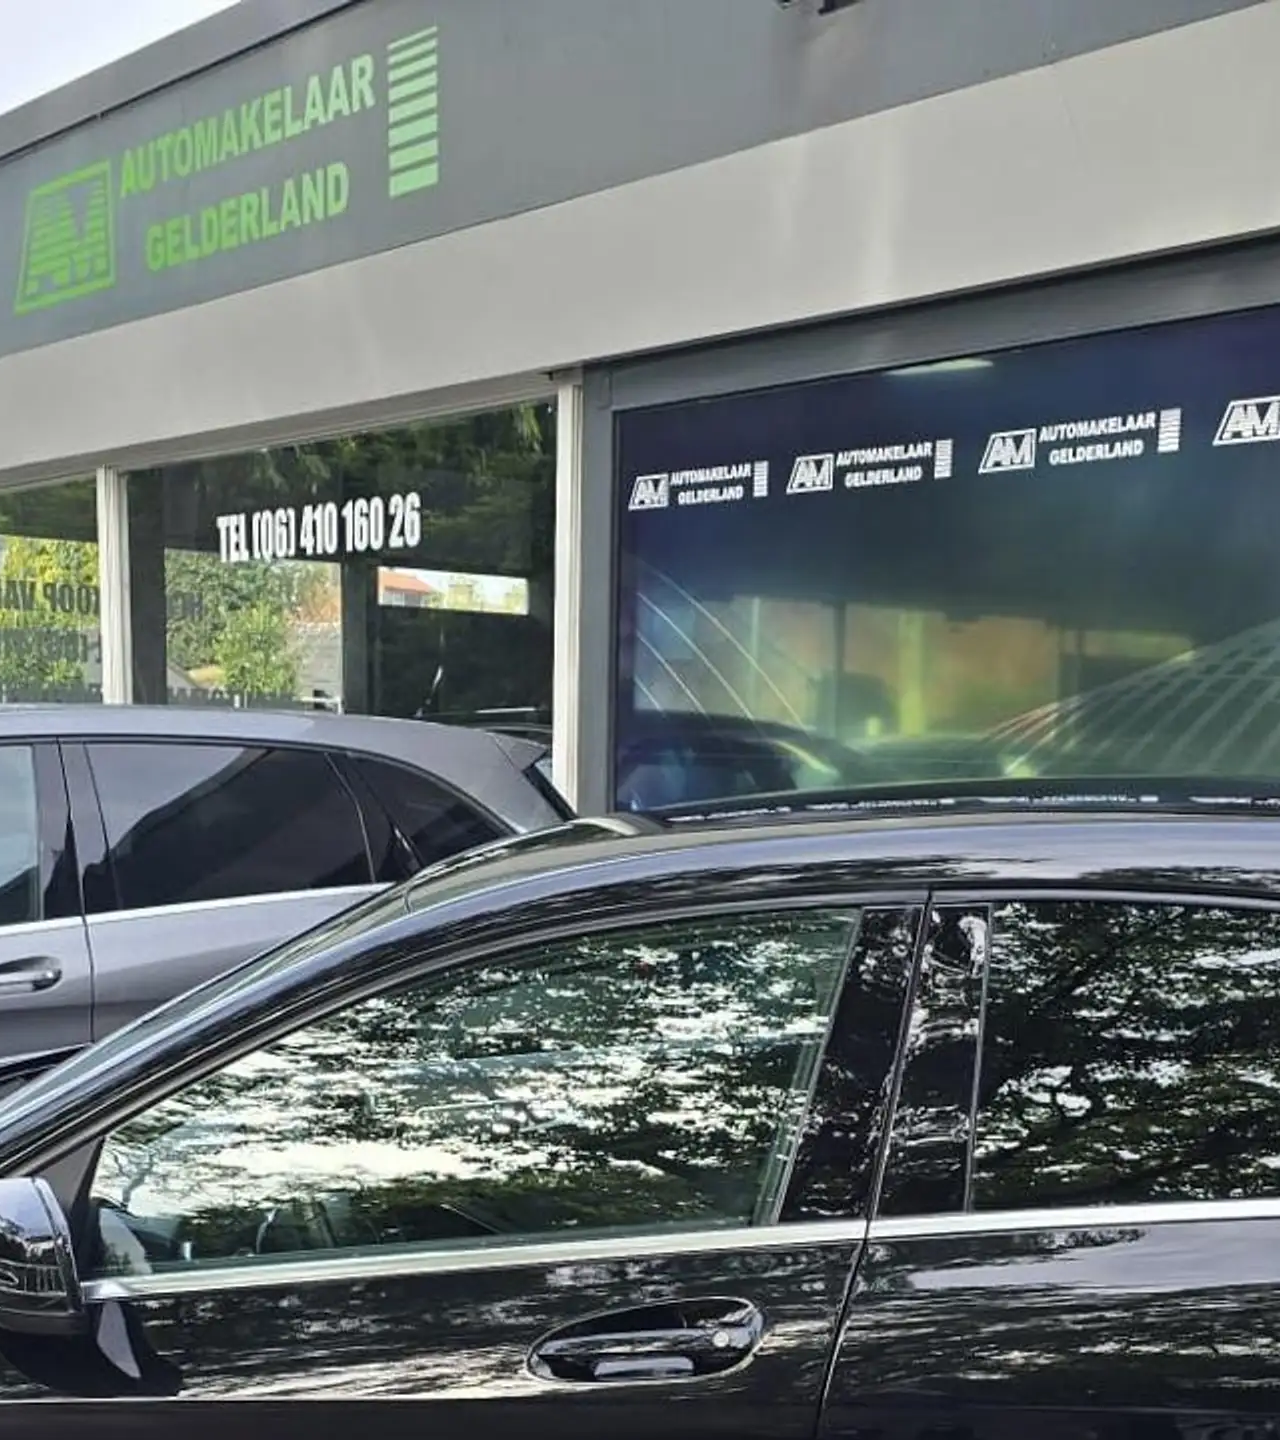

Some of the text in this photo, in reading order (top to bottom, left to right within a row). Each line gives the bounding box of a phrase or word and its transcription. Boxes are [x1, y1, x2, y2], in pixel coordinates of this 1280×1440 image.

[121, 54, 376, 196] AUTOMAKELAAR
[144, 162, 350, 272] GELDERLAND
[1038, 411, 1156, 443] AUTOMAKELAAR
[836, 442, 933, 467] AUTOMAKELAAR
[1049, 439, 1144, 466] GELDERLAND
[670, 463, 752, 486] AUTOMAKELAAR
[844, 465, 923, 488] GELDERLAND
[677, 485, 744, 506] GELDERLAND
[216, 492, 421, 563] TEL (06) 410 160 26
